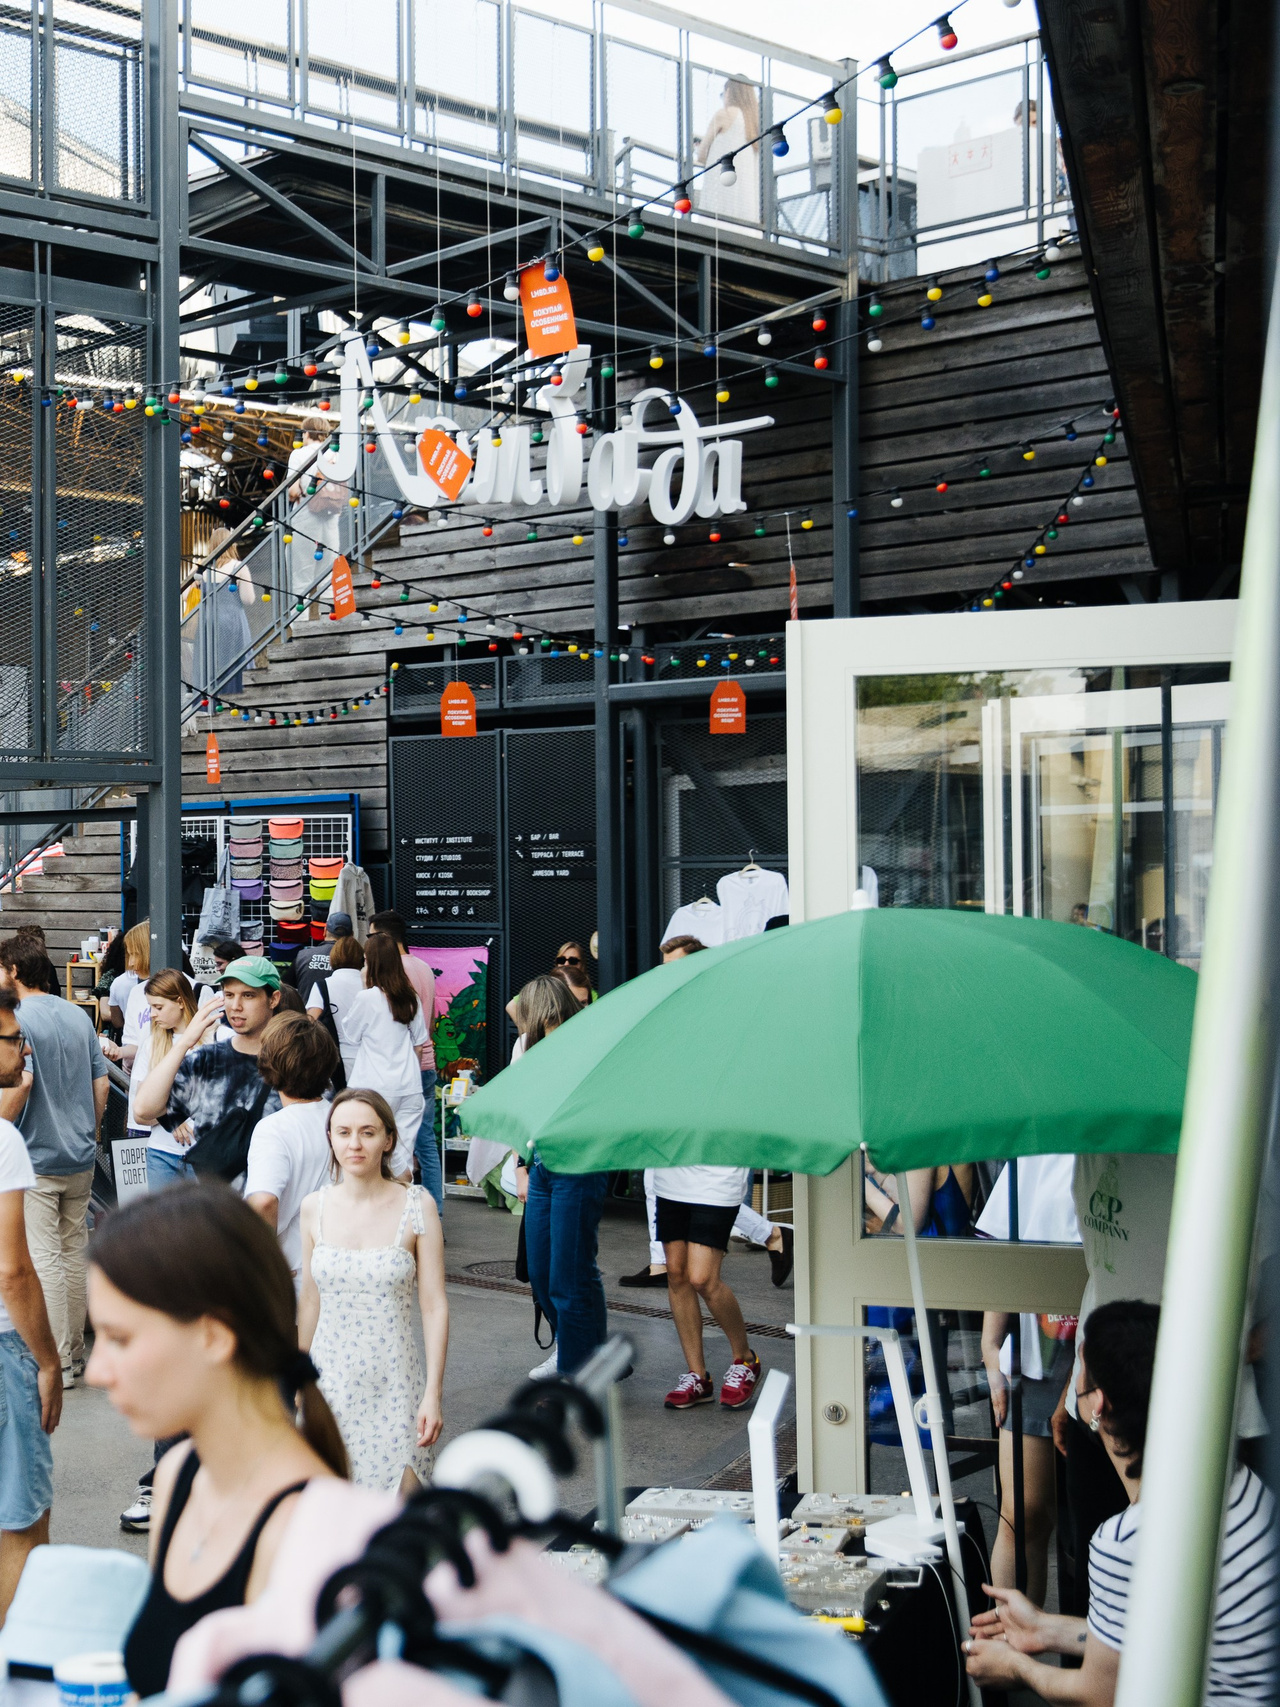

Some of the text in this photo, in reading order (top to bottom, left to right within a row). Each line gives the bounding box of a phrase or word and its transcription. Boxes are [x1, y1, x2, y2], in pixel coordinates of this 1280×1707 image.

[530, 285, 558, 298] LMBD.RU
[532, 303, 563, 317] ПОКУПАЙ
[530, 312, 568, 328] ОСОБЕННЫЕ
[541, 325, 560, 335] ВЕЩИ
[1083, 1215, 1130, 1242] COMPANY
